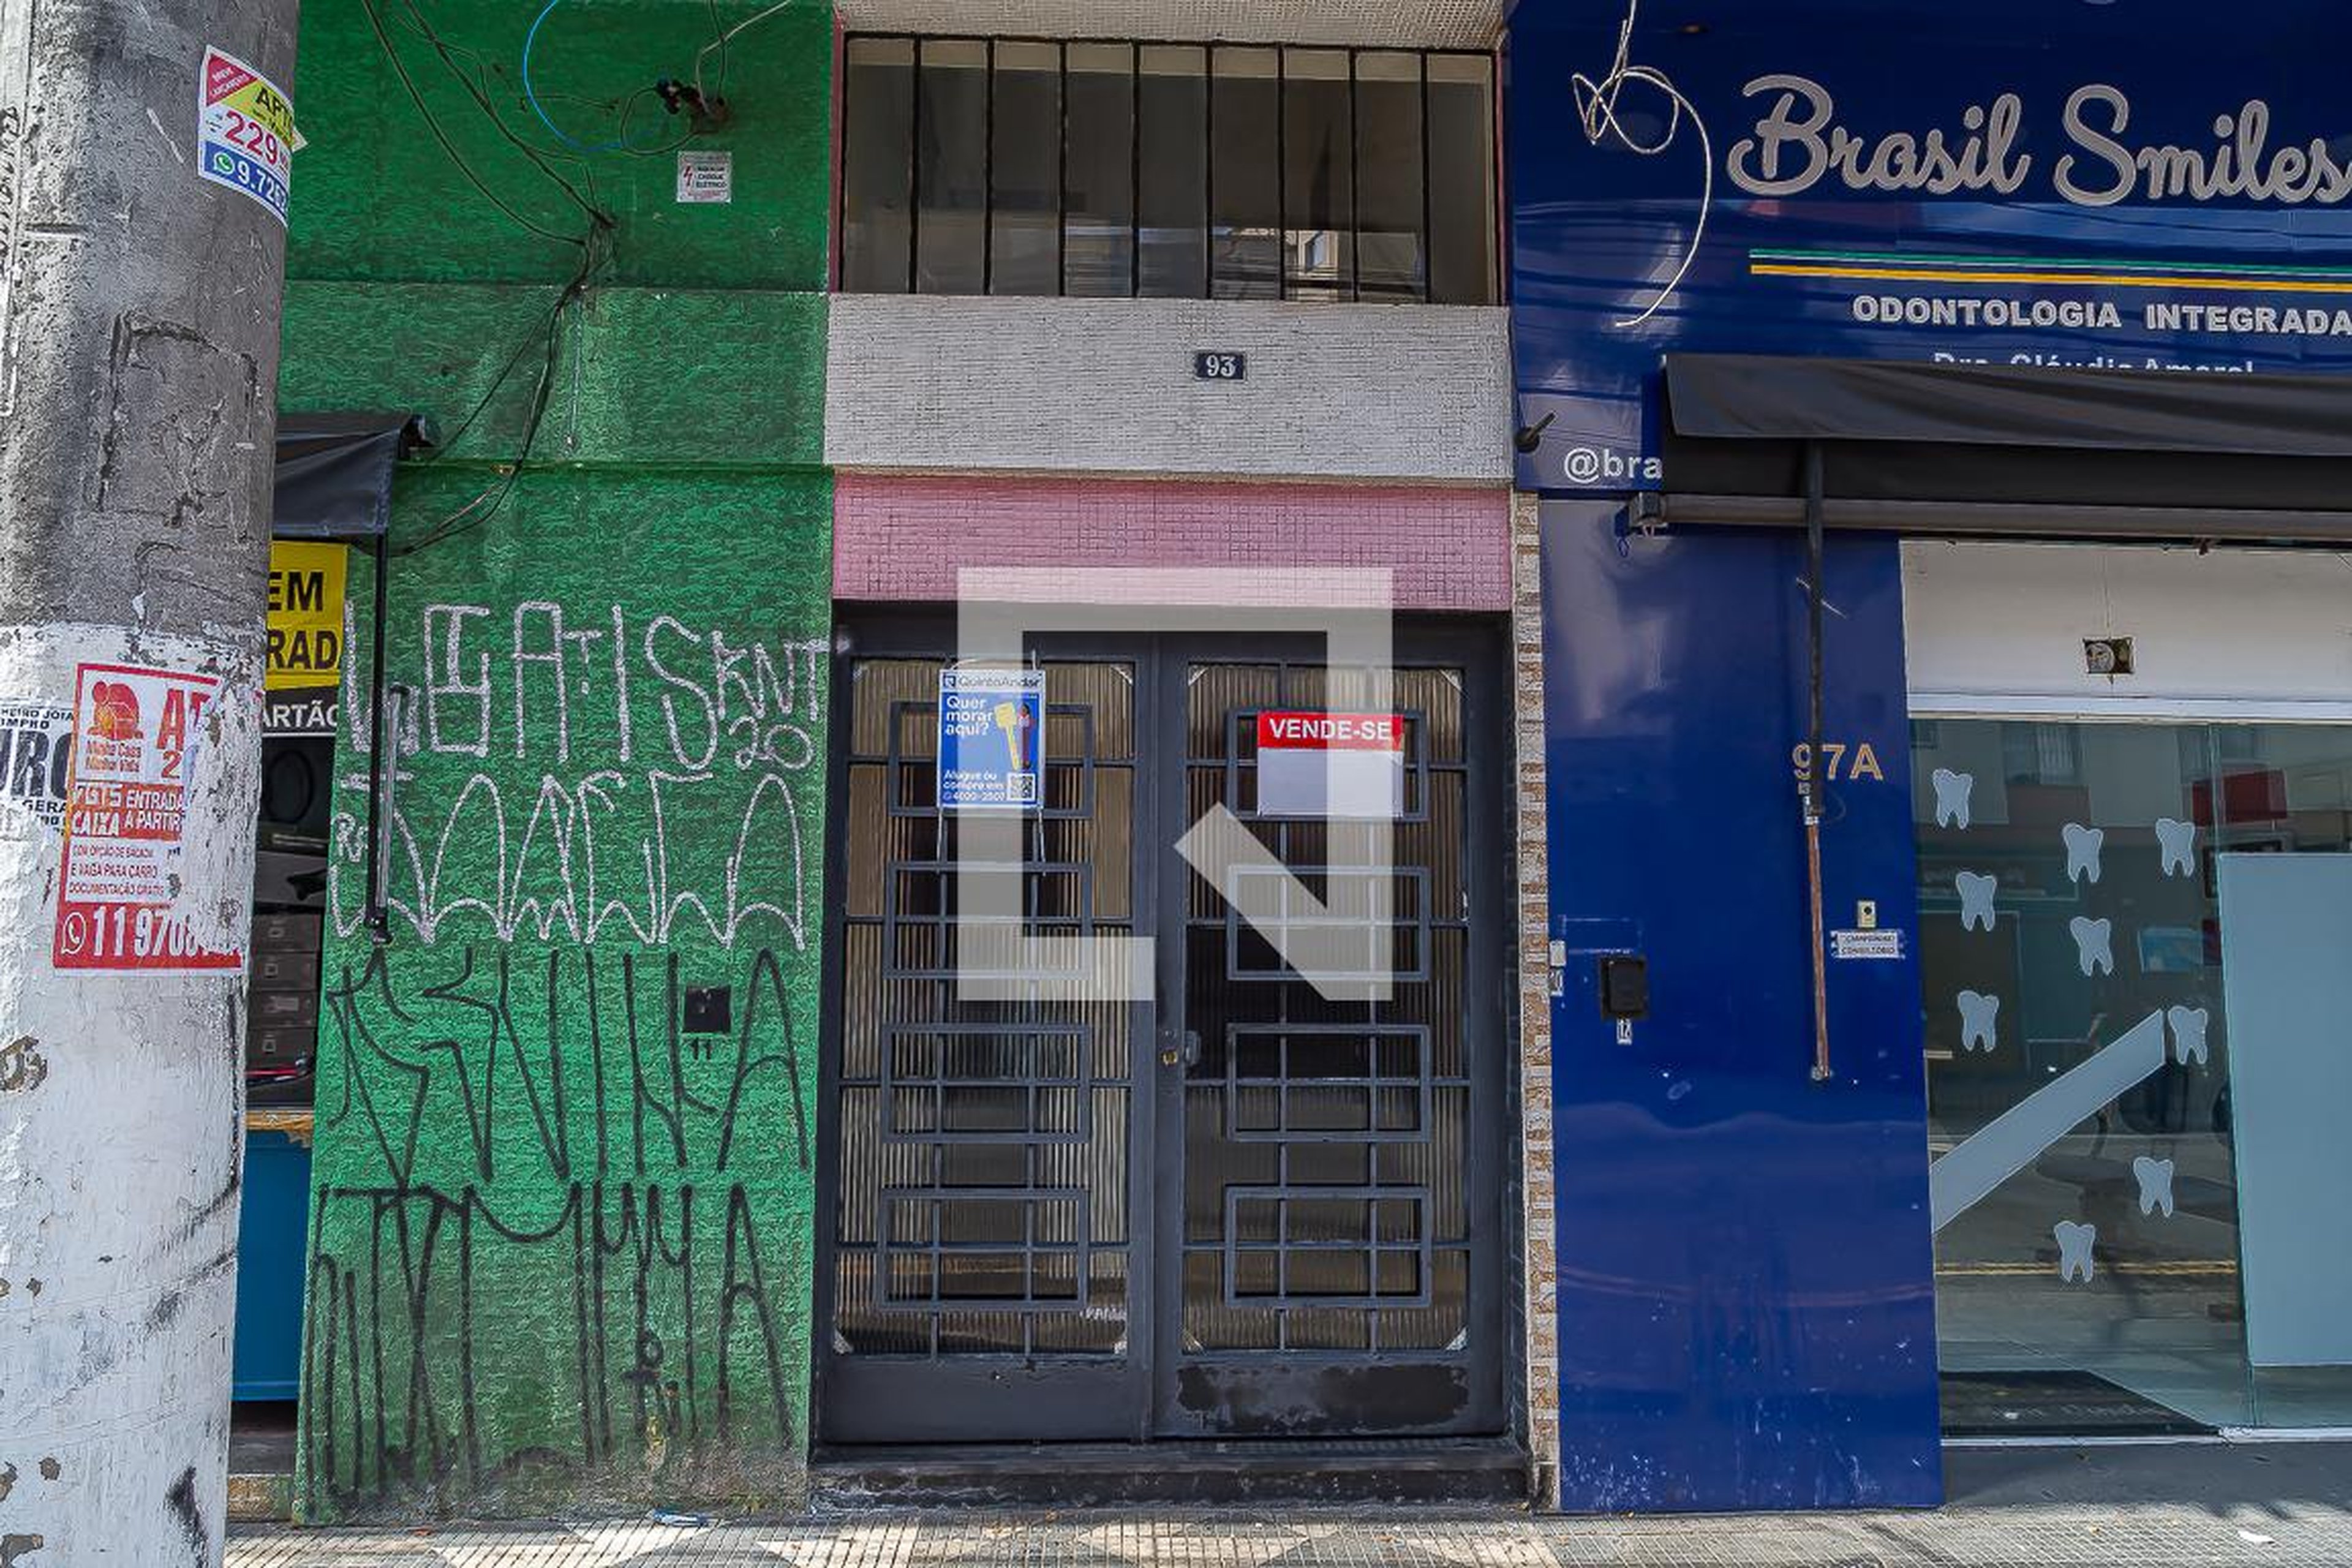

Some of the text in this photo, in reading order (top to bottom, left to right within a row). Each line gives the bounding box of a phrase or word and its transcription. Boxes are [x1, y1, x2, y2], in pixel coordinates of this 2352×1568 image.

[225, 110, 278, 165] 229
[1727, 74, 2352, 206] Brasil Smiles
[1853, 295, 2352, 336] ODONTOLOGIA INTEGRADA
[1206, 355, 1235, 377] 93
[1564, 448, 1662, 484] @bra
[946, 696, 987, 710] Quer
[946, 712, 993, 722] morar
[946, 723, 990, 739] aqui?
[1269, 718, 1392, 741] VENDE-SE
[126, 789, 184, 810] ENTRADA
